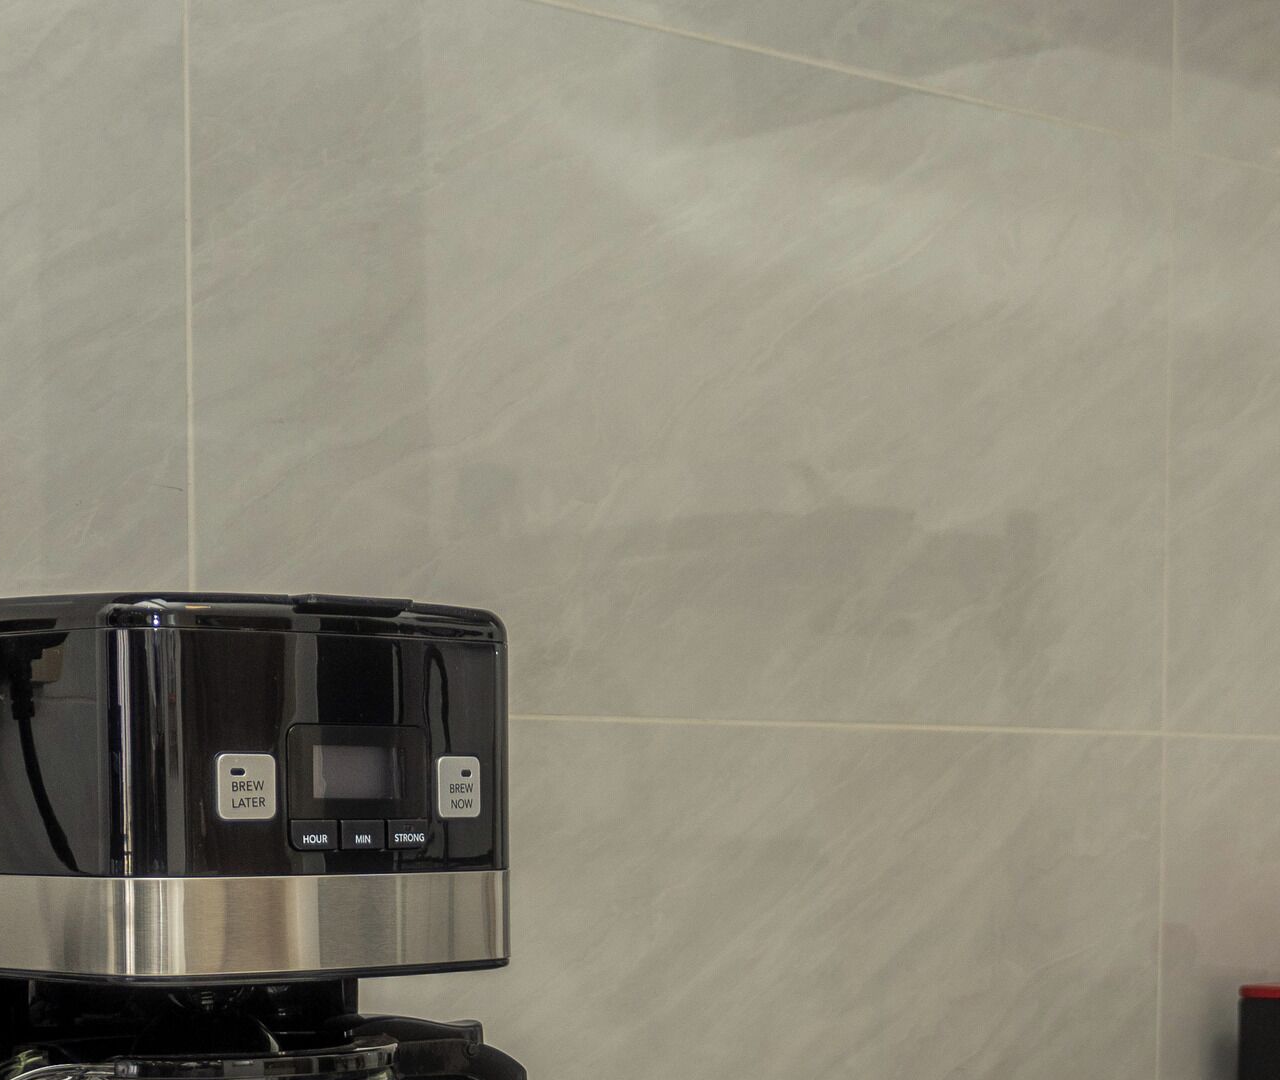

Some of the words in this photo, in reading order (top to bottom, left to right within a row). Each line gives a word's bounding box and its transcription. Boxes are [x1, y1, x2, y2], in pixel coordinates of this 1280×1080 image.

[231, 780, 265, 792] BREW
[449, 783, 474, 794] BREW
[231, 796, 266, 809] LATER
[450, 798, 473, 810] NOW
[302, 834, 328, 844] HOUR
[355, 834, 371, 844] MIN
[394, 832, 425, 843] STRONG
